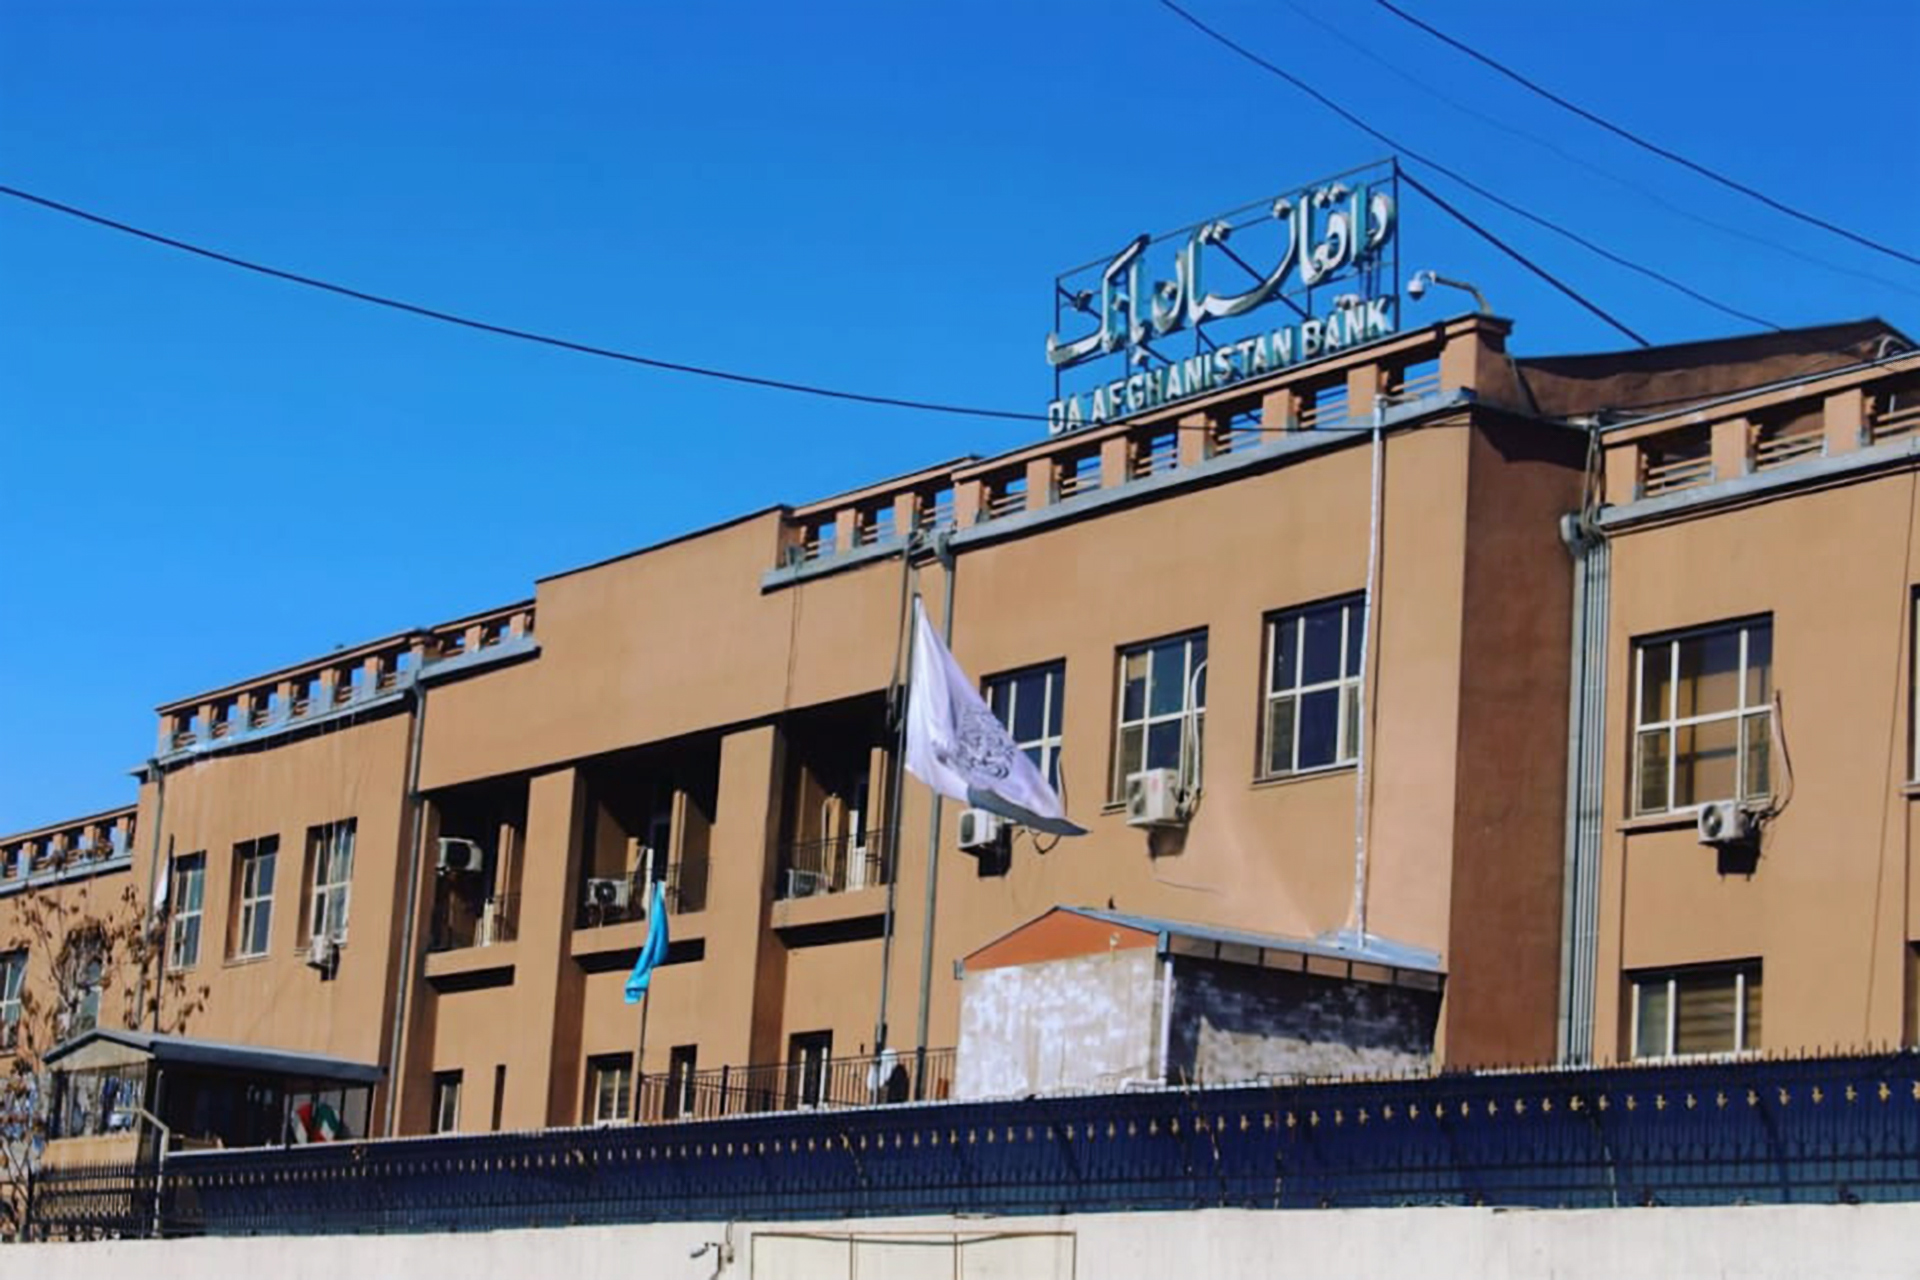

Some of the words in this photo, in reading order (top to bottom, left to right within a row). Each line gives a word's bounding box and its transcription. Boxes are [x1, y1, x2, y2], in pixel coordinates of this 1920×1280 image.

[1048, 392, 1092, 436] DA
[1091, 324, 1300, 426] AFGHANISTAN
[1301, 297, 1397, 358] BANK
